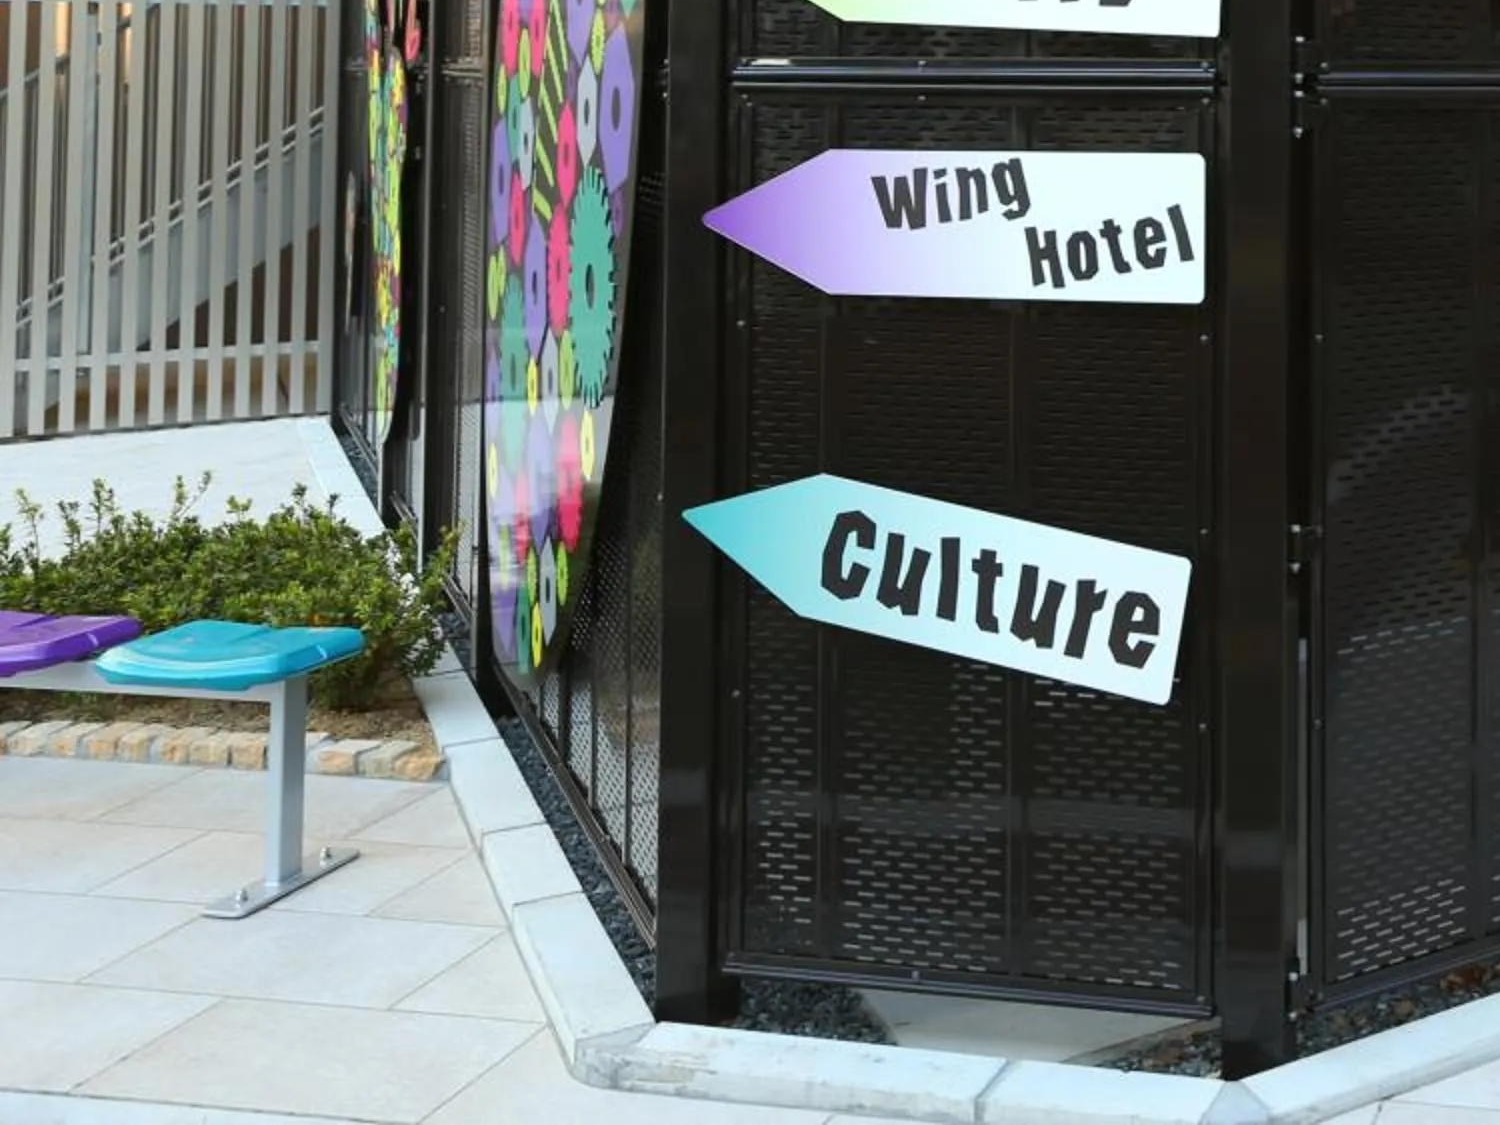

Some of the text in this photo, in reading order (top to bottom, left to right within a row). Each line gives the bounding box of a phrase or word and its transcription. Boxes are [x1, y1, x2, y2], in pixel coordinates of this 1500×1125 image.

[871, 158, 1031, 230] Wing
[1025, 203, 1195, 289] Hotel
[820, 510, 1160, 670] Culture
